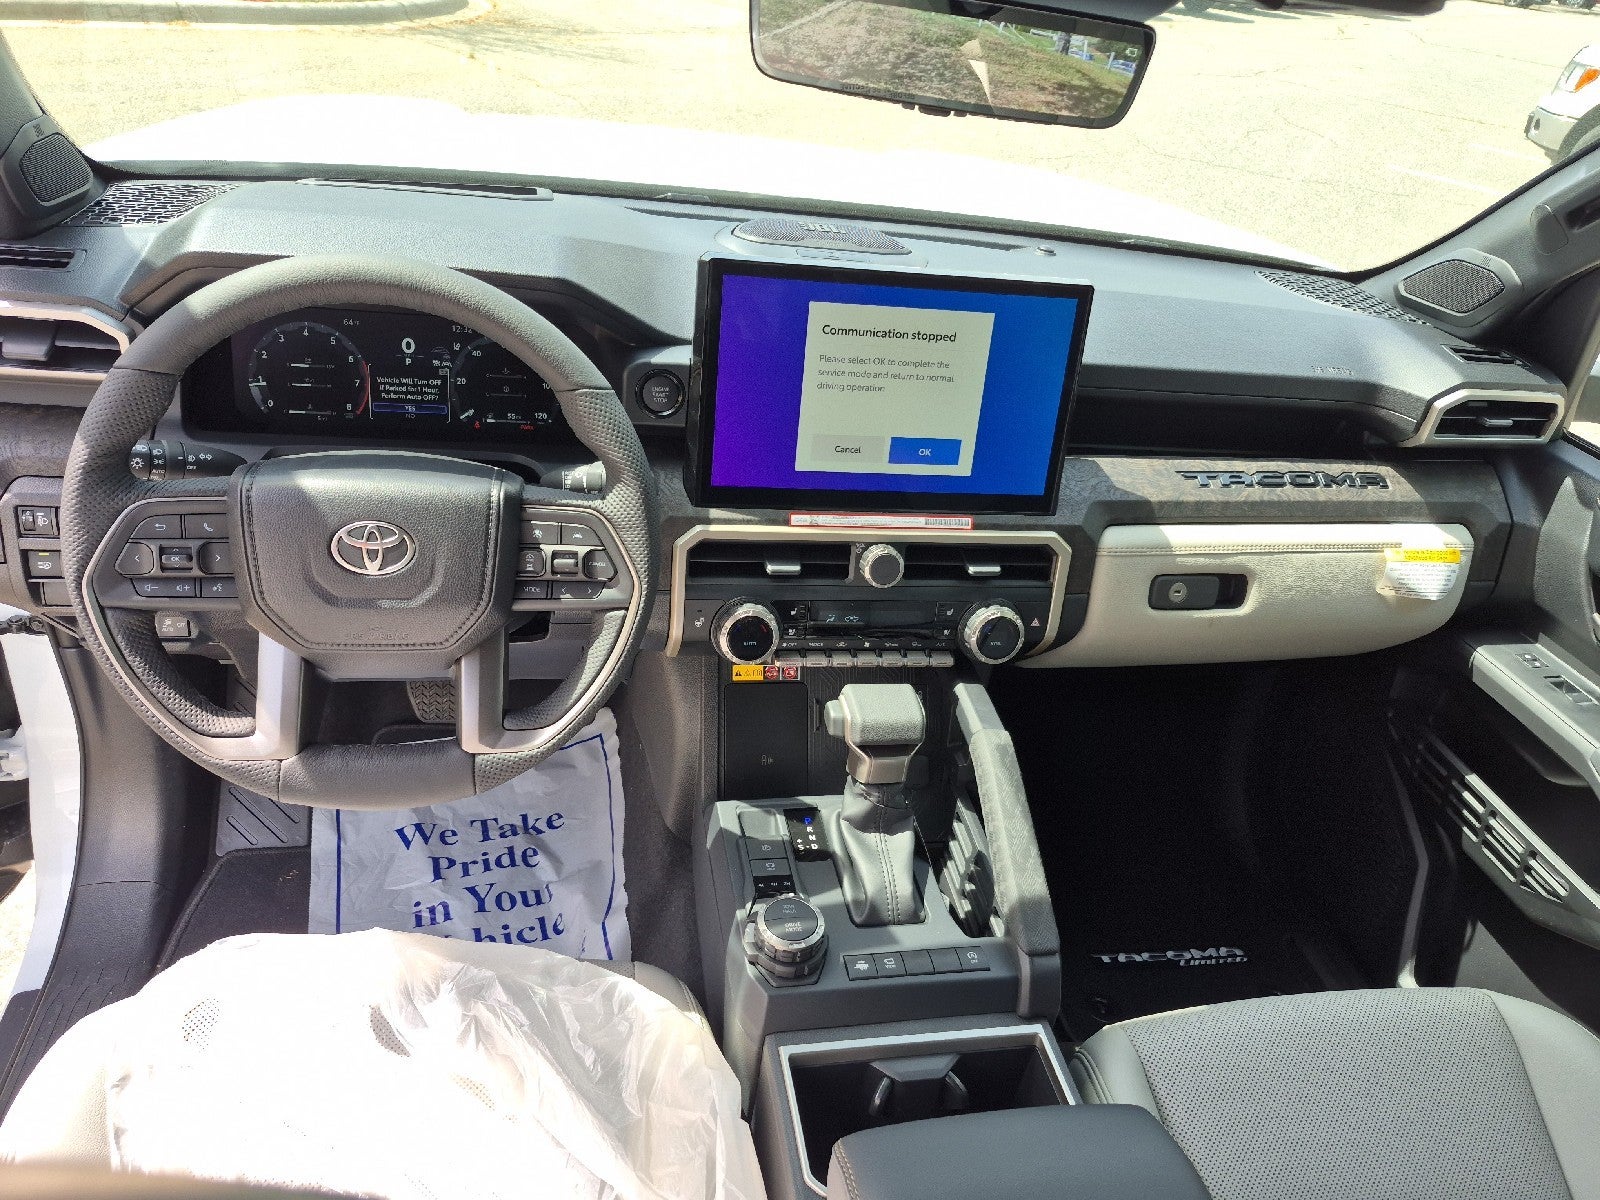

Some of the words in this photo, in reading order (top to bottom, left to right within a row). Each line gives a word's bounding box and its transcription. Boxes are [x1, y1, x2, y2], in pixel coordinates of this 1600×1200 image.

[302, 328, 309, 337] 4
[822, 324, 909, 340] Communication
[911, 330, 957, 343] stopped
[279, 333, 285, 342] 3
[330, 336, 336, 345] 5
[401, 337, 416, 354] 0
[261, 350, 268, 359] 2
[348, 355, 354, 363] 6
[405, 357, 412, 366] P
[819, 354, 846, 364] Please
[847, 355, 871, 365] select
[872, 357, 886, 366] OK
[887, 358, 896, 366] to
[897, 359, 935, 370] complete
[936, 360, 950, 369] the
[818, 368, 846, 377] service
[847, 369, 872, 379] mode
[872, 370, 888, 380] and
[890, 371, 915, 381] return
[915, 372, 925, 381] to
[925, 373, 955, 383] normal
[354, 379, 360, 387] 7
[400, 377, 413, 385] Will
[456, 377, 467, 385] 20
[385, 384, 407, 392] Parked
[816, 381, 845, 392] driving
[381, 392, 406, 400] Perform
[267, 399, 274, 407] 0
[534, 412, 548, 420] 120
[834, 445, 862, 454] Cancel
[918, 448, 931, 457] OK
[1175, 470, 1390, 489] TACOMA
[394, 822, 459, 850] We
[470, 811, 566, 843] Take
[427, 845, 540, 883] Pride
[412, 899, 454, 929] in
[1091, 947, 1245, 963] TACOMA
